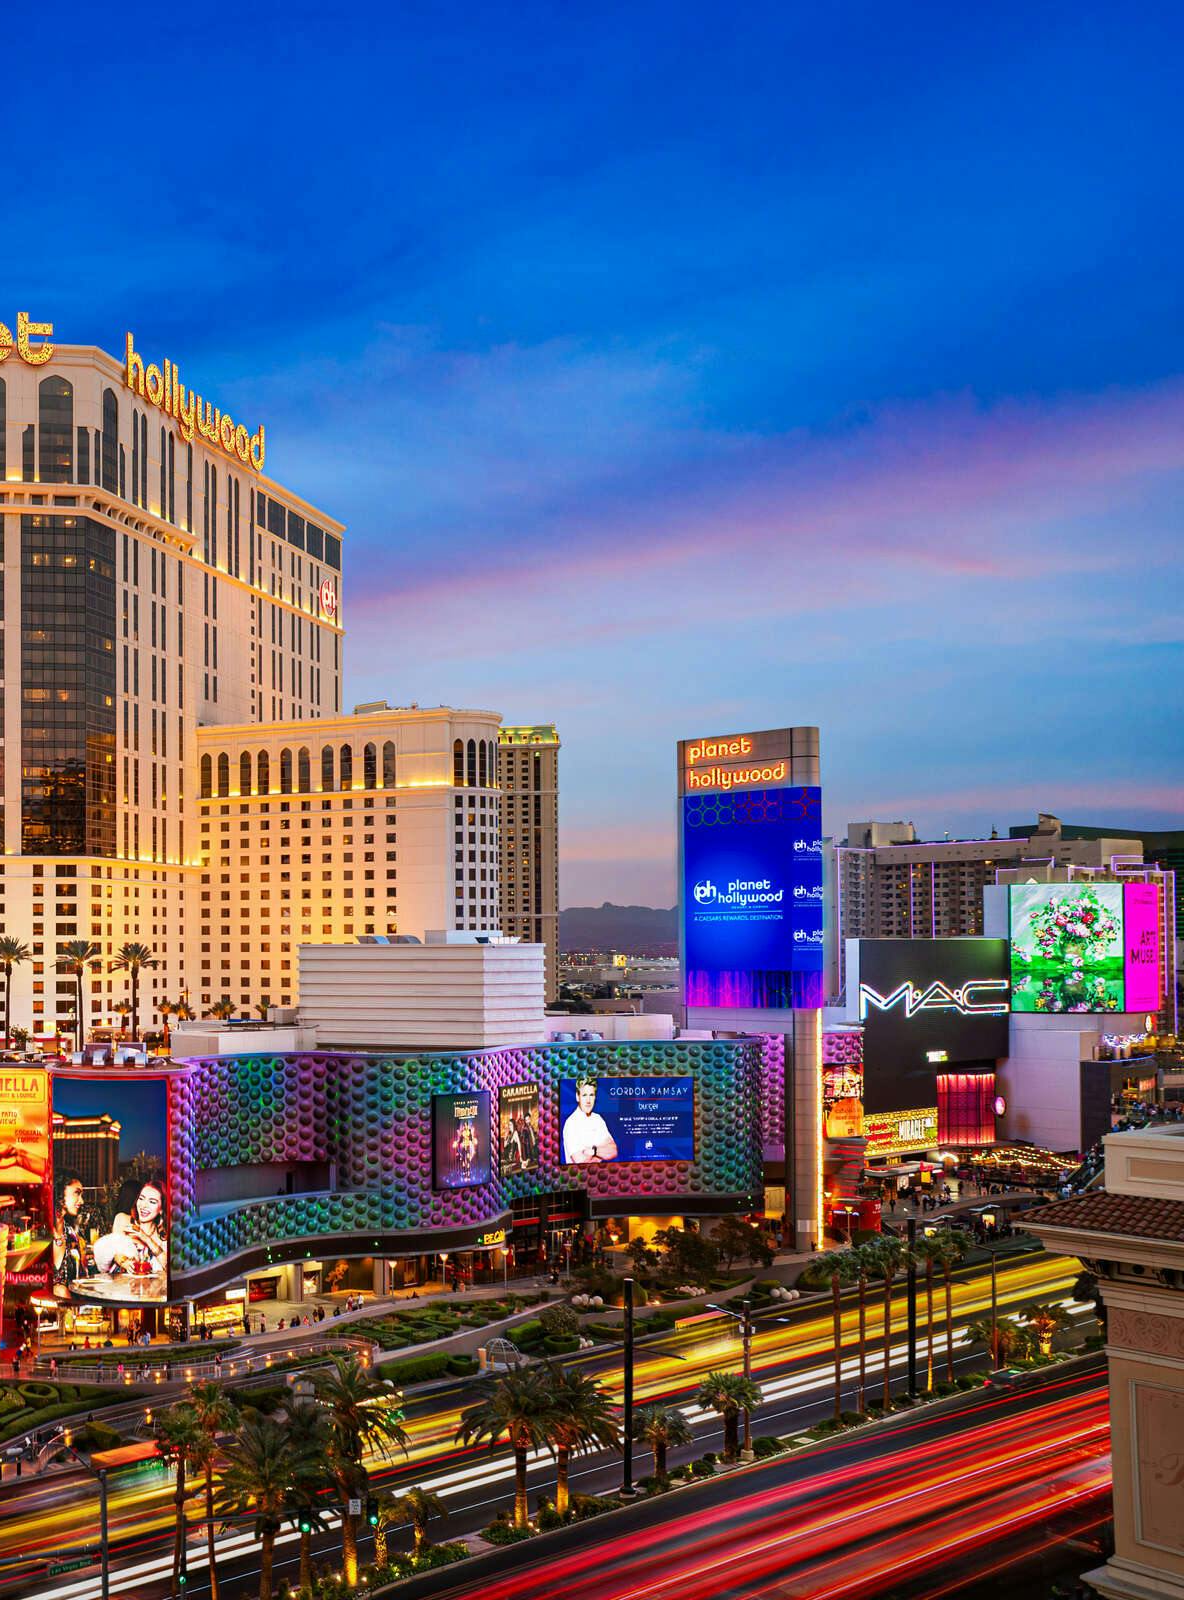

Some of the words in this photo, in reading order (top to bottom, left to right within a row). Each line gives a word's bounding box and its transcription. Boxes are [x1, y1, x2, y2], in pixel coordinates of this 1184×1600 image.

[126, 331, 265, 471] hollywood
[689, 737, 751, 764] planet
[689, 762, 785, 789] hollywood
[695, 880, 717, 901] ph
[718, 889, 783, 906] hollywood
[728, 879, 771, 893] planet
[502, 1085, 538, 1098] CARAMELLA
[609, 1087, 647, 1096] GORDON
[651, 1087, 688, 1096] RAMSAY
[638, 1102, 659, 1111] burger
